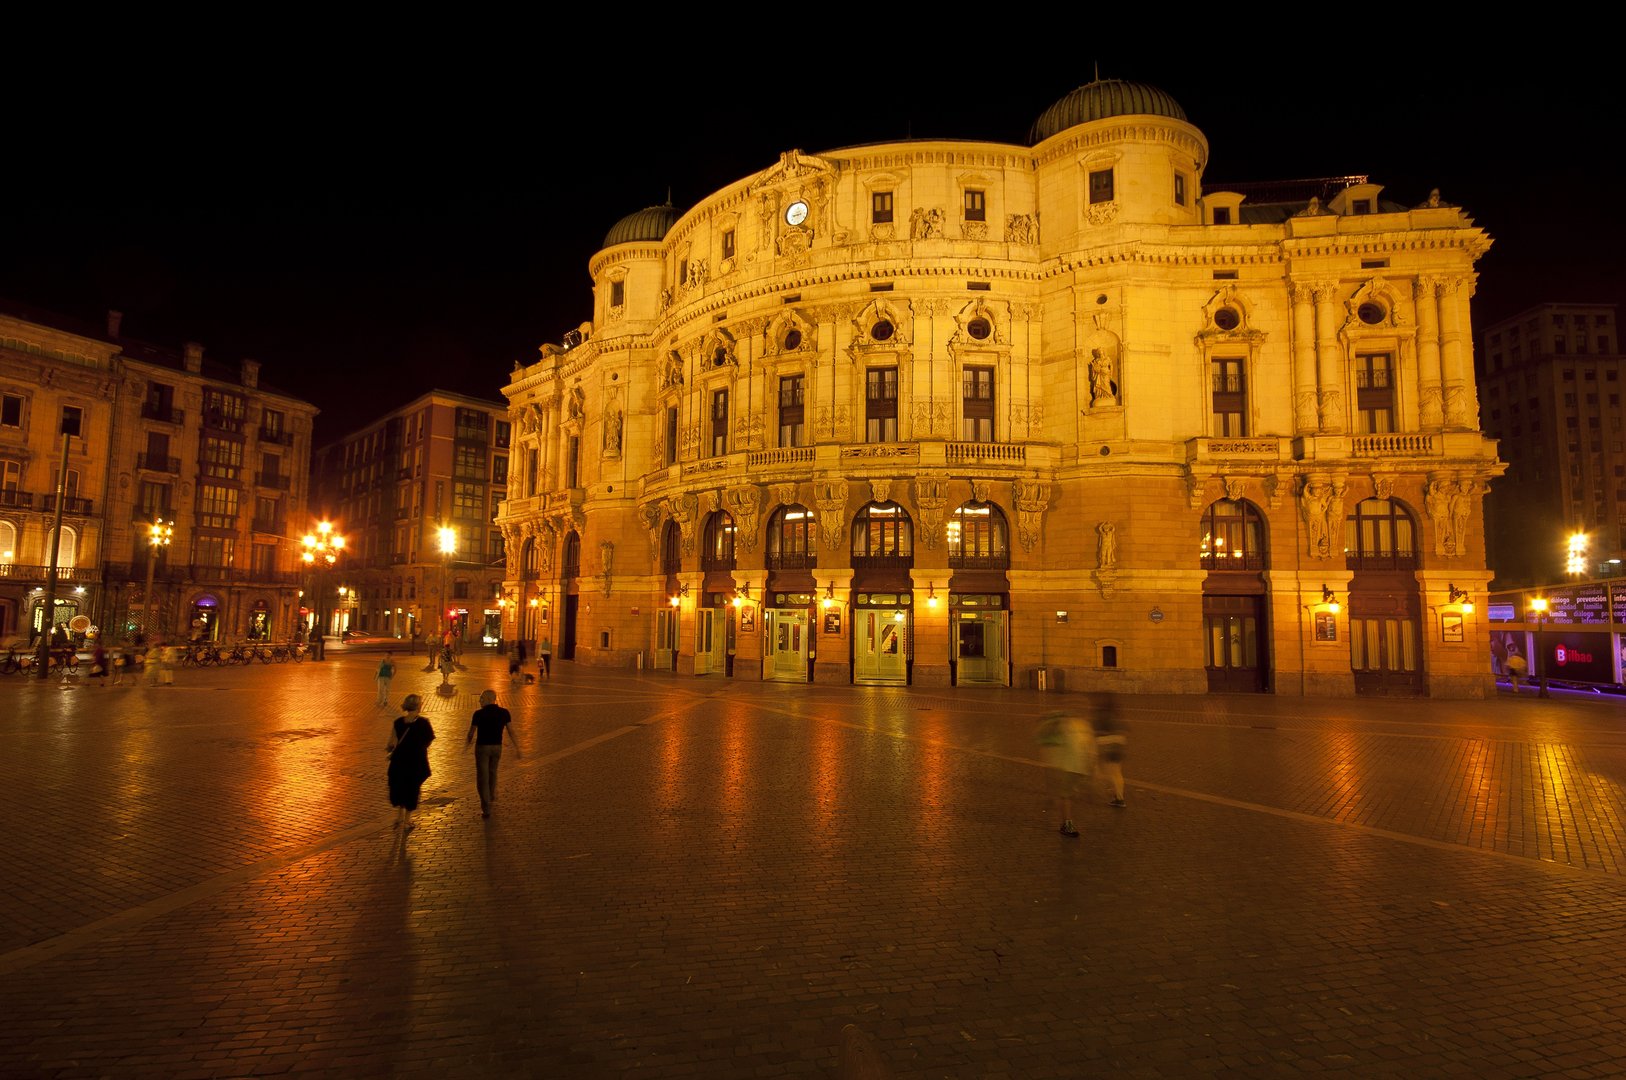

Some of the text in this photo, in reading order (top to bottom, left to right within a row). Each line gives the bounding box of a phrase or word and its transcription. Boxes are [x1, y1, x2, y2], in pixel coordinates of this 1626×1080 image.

[1551, 595, 1606, 604] diálogo prevención
[1557, 649, 1592, 662] Bilbao
